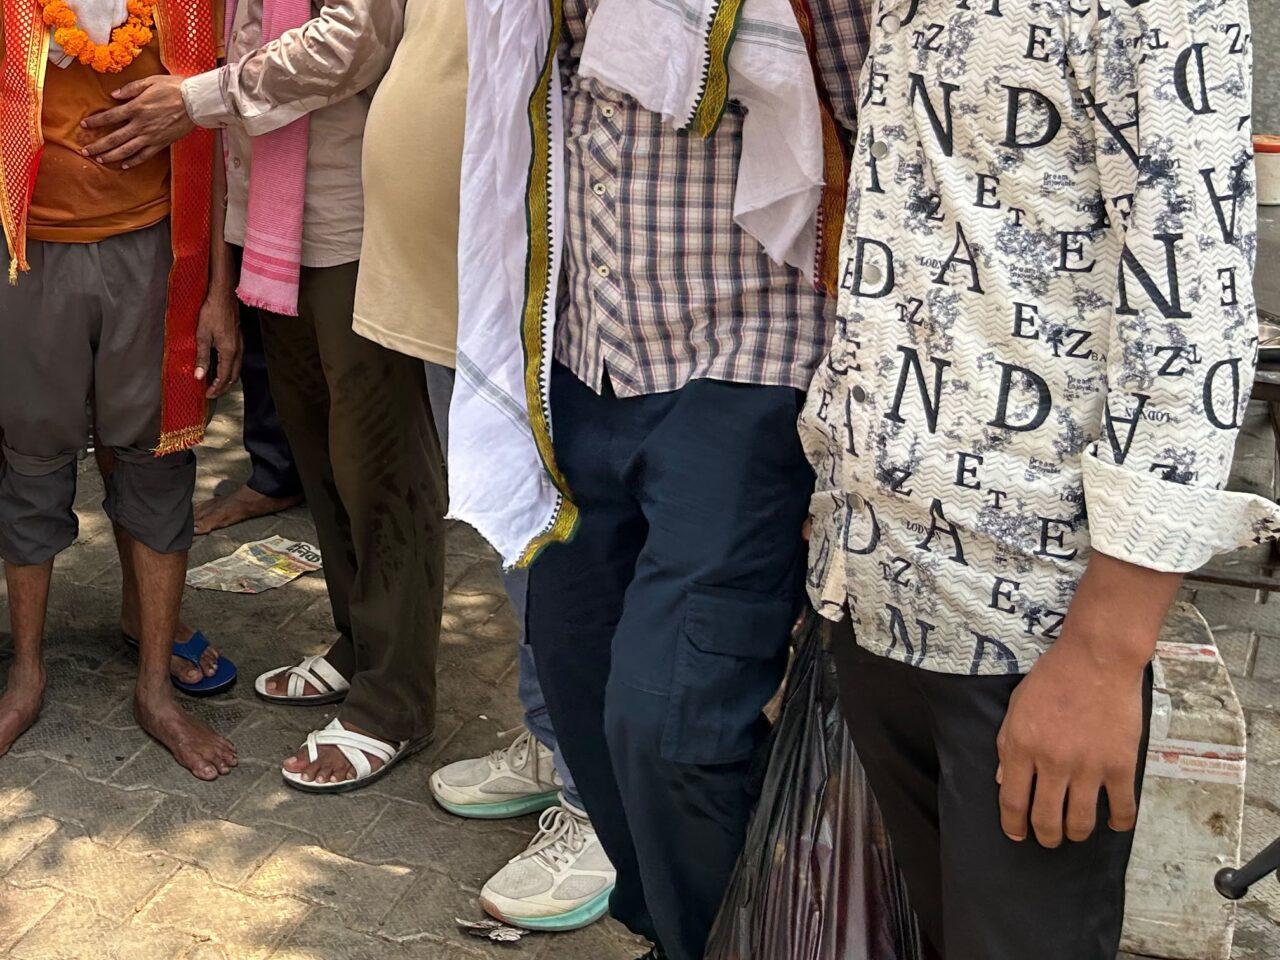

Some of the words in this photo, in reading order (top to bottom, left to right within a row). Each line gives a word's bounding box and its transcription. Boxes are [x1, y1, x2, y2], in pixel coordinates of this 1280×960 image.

[1023, 23, 1052, 62] E
[908, 72, 960, 157] N
[1001, 84, 1062, 149] D
[973, 172, 1001, 210] E
[1007, 206, 1026, 228] T
[851, 236, 895, 299] D
[931, 221, 985, 295] A
[1053, 230, 1096, 273] E
[1011, 302, 1039, 340] E
[883, 345, 952, 434] N
[986, 360, 1052, 432] D
[953, 451, 984, 490] E
[987, 488, 1007, 509] T
[915, 498, 969, 566] A
[1033, 516, 1078, 560] E
[988, 576, 1020, 614] E
